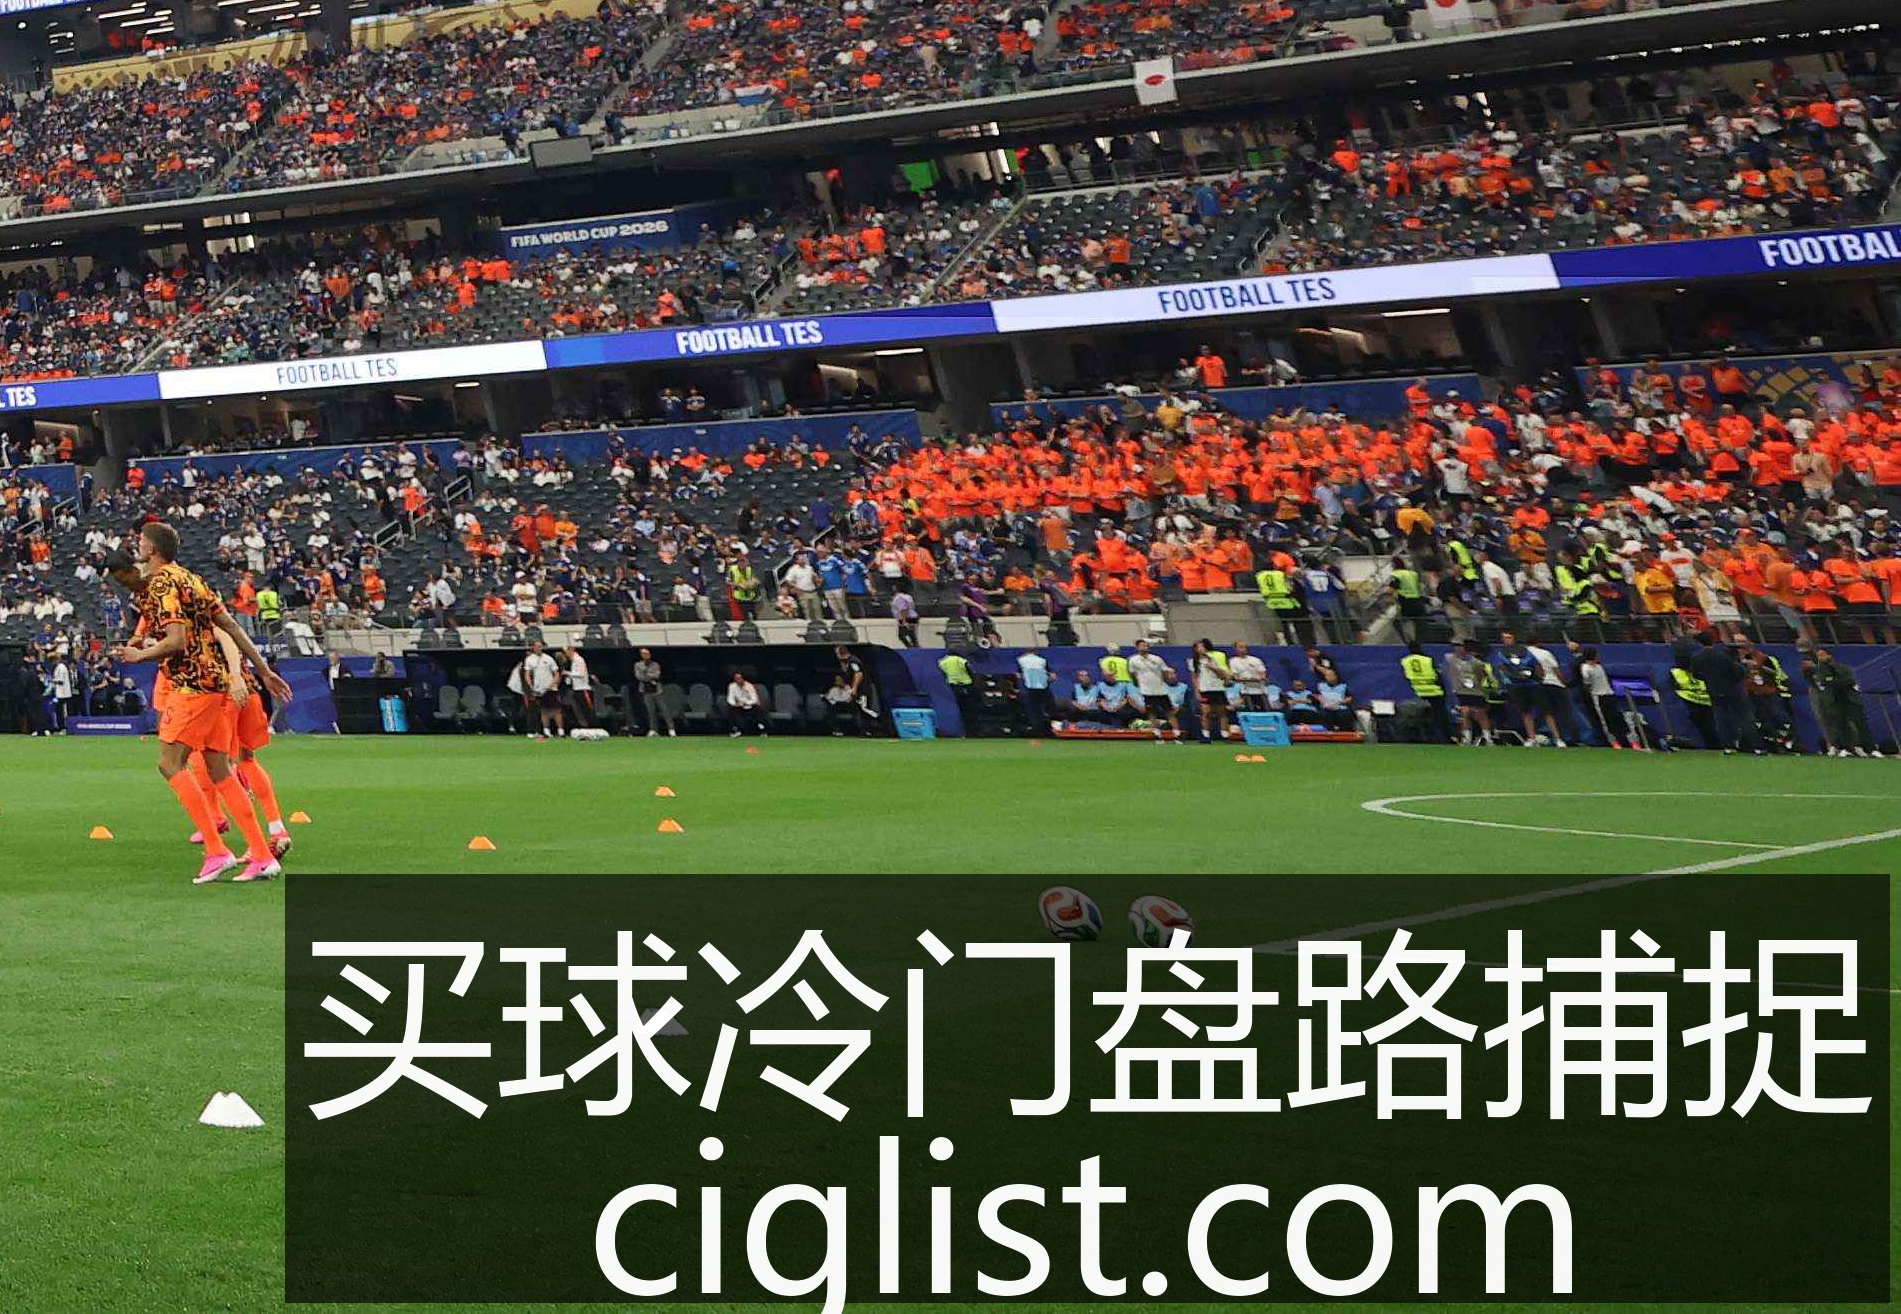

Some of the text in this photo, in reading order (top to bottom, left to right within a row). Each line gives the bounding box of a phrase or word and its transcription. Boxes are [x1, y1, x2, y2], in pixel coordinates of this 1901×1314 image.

[510, 220, 669, 248] FIFA WORLD CUP 2026
[1157, 281, 1289, 314] FOOTBALL
[676, 327, 781, 355] FOOTBALL
[276, 360, 360, 386] FOOTBALL
